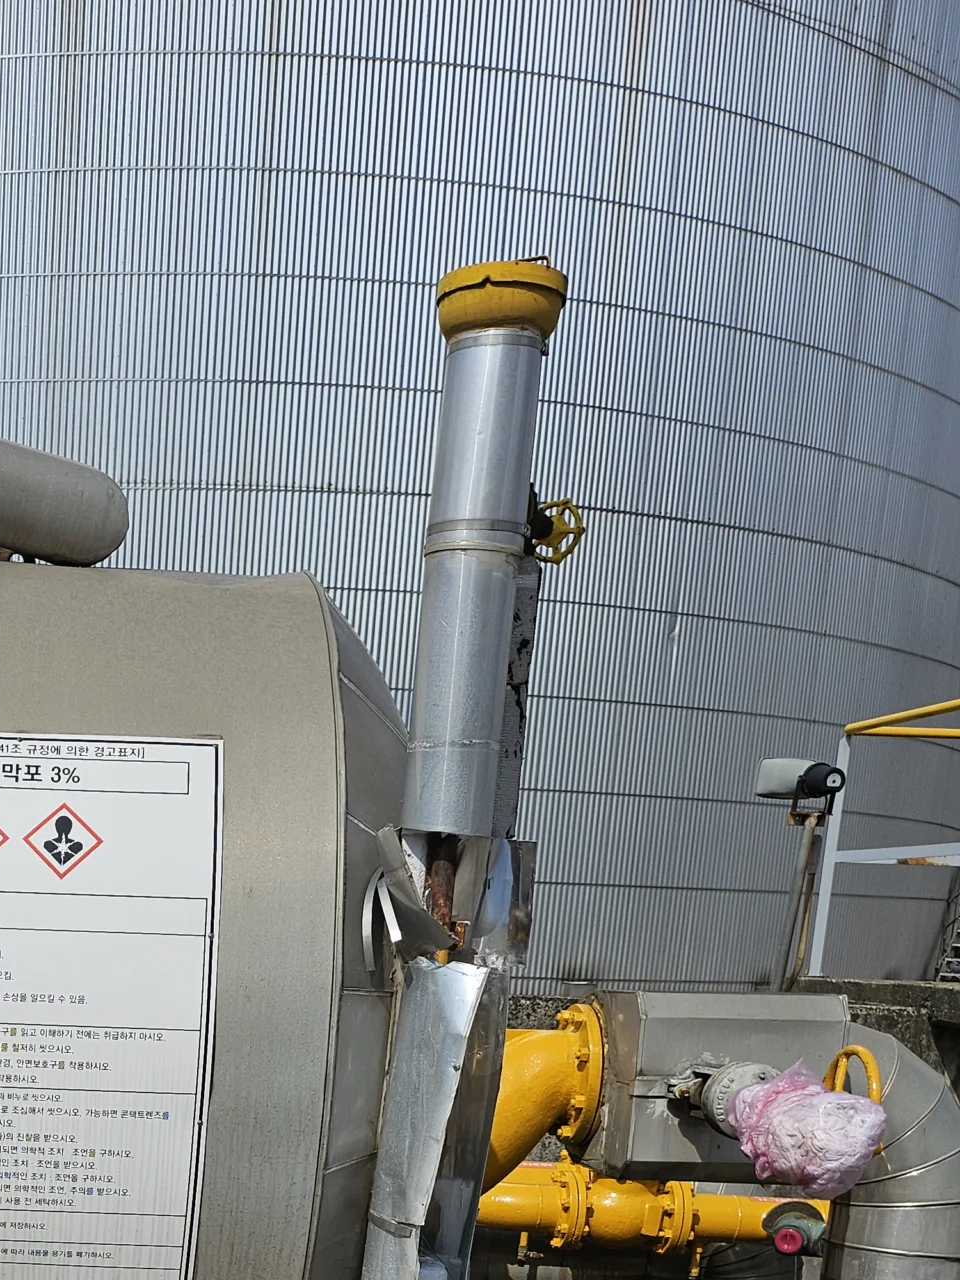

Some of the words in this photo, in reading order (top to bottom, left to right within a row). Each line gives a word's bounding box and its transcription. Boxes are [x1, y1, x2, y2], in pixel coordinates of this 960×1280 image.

[26, 744, 62, 756] 규정에
[65, 745, 90, 757] 의한
[50, 765, 81, 784] 3%
[2, 992, 28, 1003] 손상을
[30, 993, 55, 1004] 일으킬
[57, 994, 66, 1004] 수
[69, 994, 88, 1005] 있음.
[20, 1027, 37, 1038] 읽고
[39, 1028, 73, 1039] 이해하기
[75, 1029, 101, 1040] 전에는
[103, 1030, 137, 1042] 취급하지
[138, 1032, 167, 1042] 마시오.
[38, 1044, 75, 1055] 씻으시오.
[16, 1058, 66, 1070] 안면보호구를
[68, 1060, 112, 1072] 착용하시오.
[7, 1092, 29, 1102] 비누로
[31, 1093, 64, 1103] 씻으시오.
[11, 1105, 45, 1116] 조심해서
[46, 1107, 82, 1118] 씻으시오.
[85, 1108, 118, 1119] 가능하면
[43, 1133, 78, 1144] 받으시오.
[21, 1146, 45, 1156] 의학적
[47, 1147, 64, 1157] 조치
[71, 1148, 96, 1158] 조언을
[98, 1148, 134, 1159] 구하시오.
[11, 1158, 29, 1168] 조치
[36, 1159, 61, 1170] 조언을
[63, 1160, 98, 1171] 받으시오.
[30, 1172, 47, 1182] 조치
[54, 1173, 78, 1183] 조언을
[81, 1174, 116, 1184] 구하시오.
[13, 1184, 46, 1194] 의학적인
[48, 1185, 67, 1196] 조언,
[69, 1186, 94, 1196] 주의를
[96, 1187, 132, 1197] 받으시오.
[4, 1196, 22, 1206] 사용
[24, 1197, 32, 1206] 전
[34, 1198, 77, 1208] 세탁하시오.
[9, 1221, 48, 1231] 저장하시오.
[10, 1248, 25, 1256] 따라
